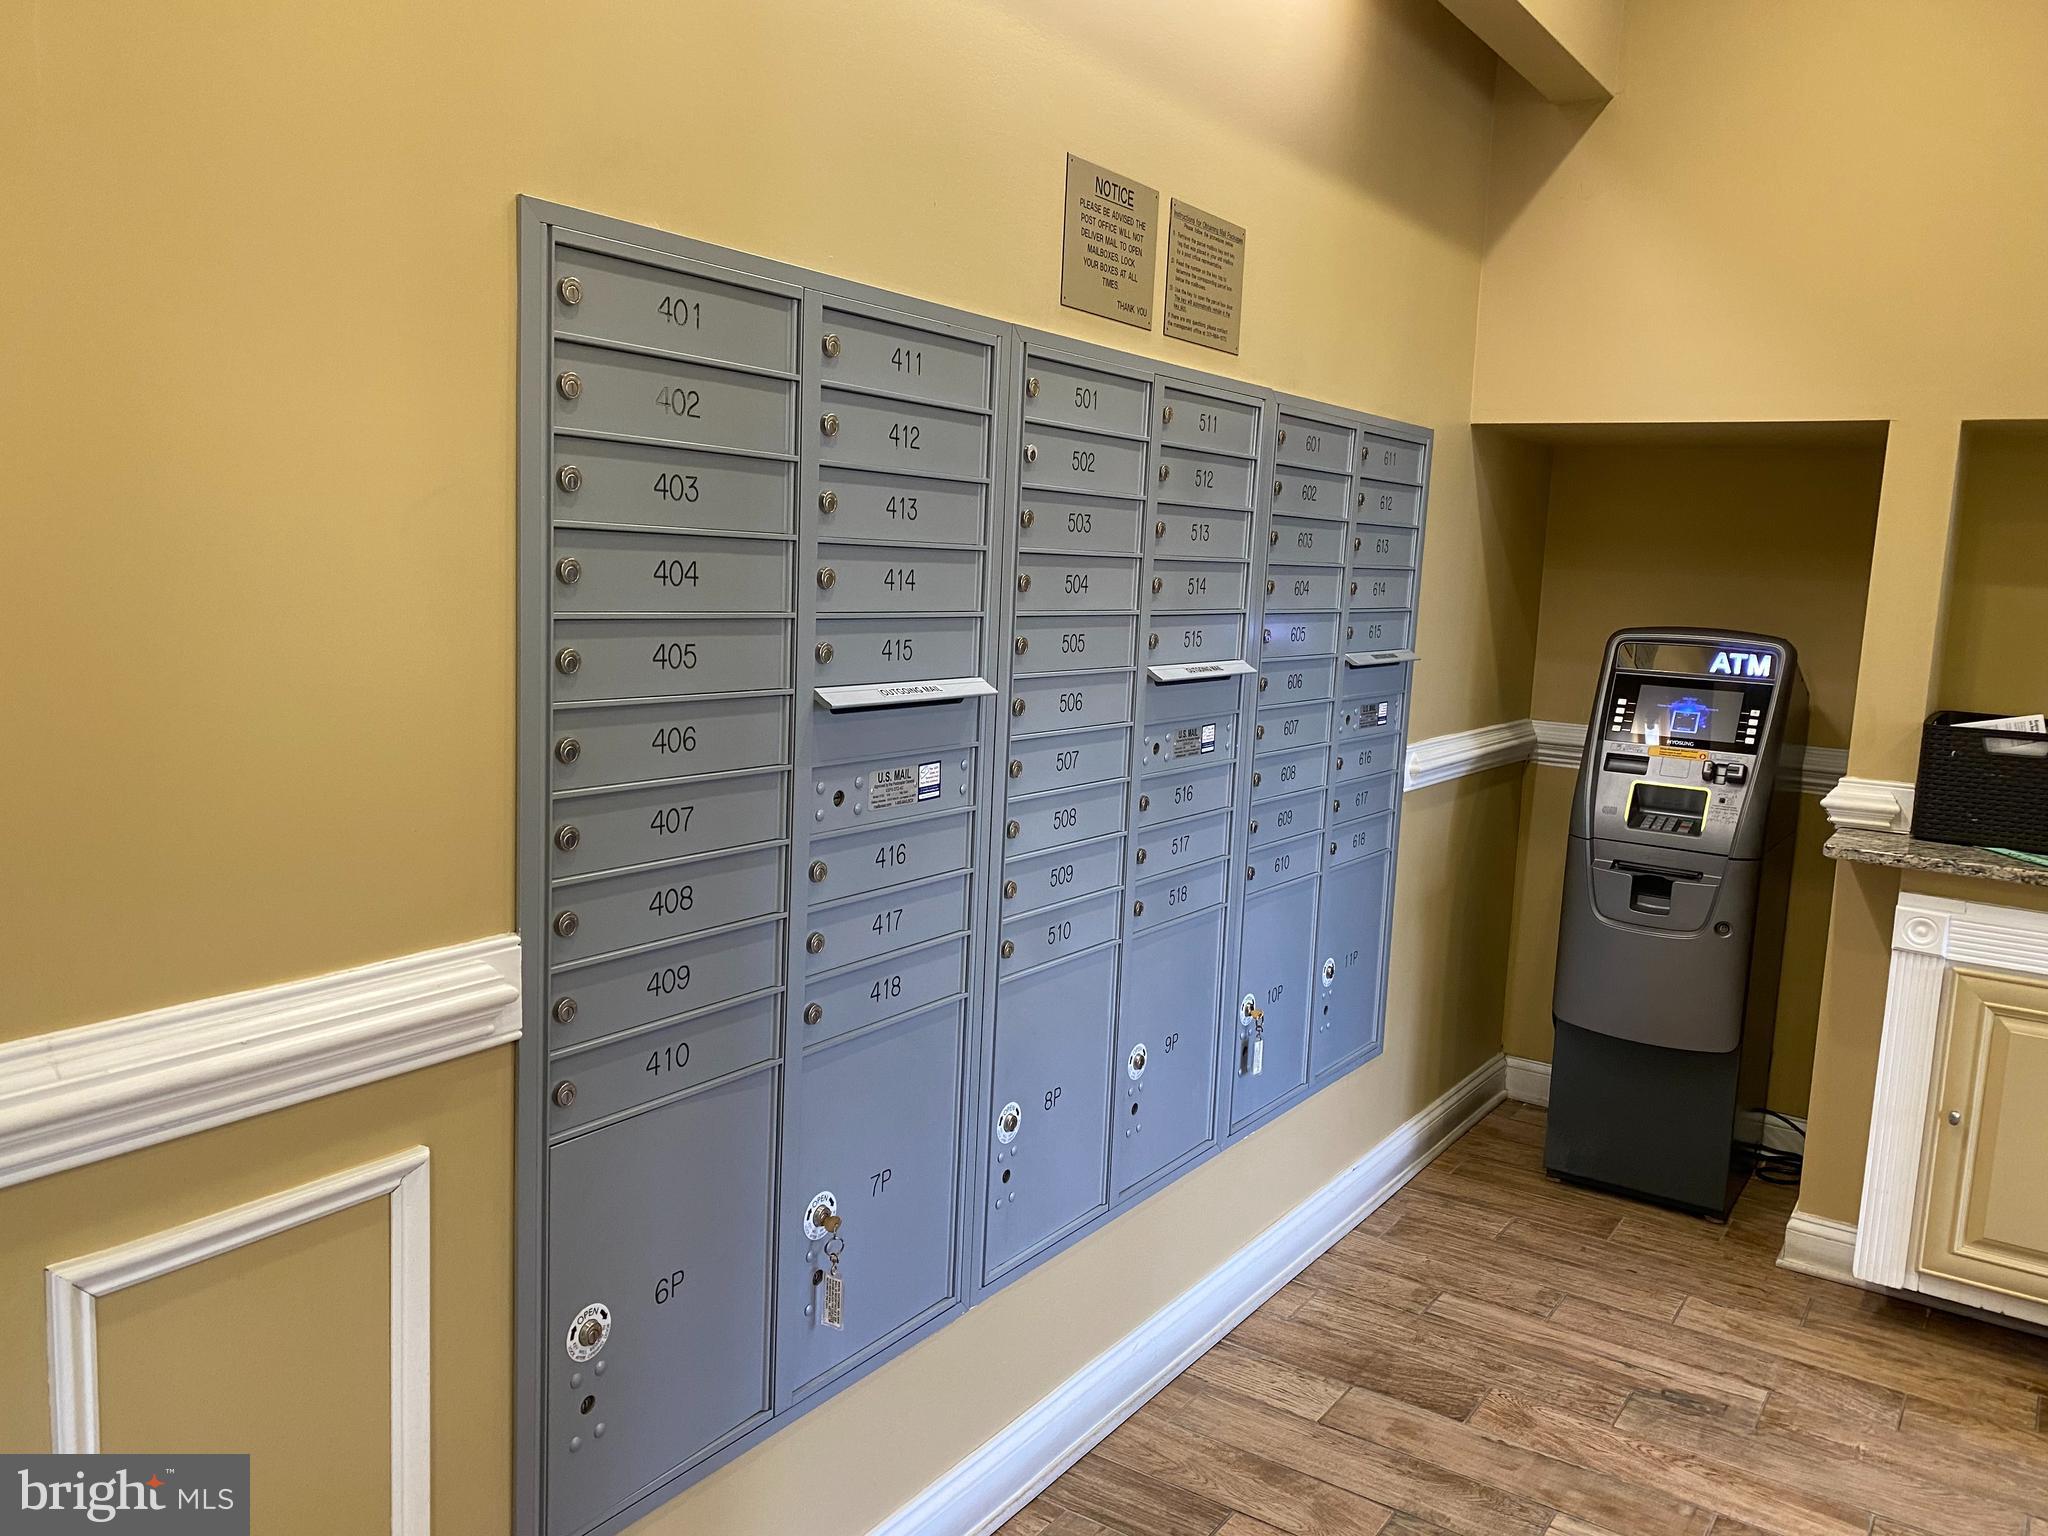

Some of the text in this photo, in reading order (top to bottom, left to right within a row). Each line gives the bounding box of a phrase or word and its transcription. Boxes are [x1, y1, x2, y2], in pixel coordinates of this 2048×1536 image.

[1095, 176, 1135, 208] NOTICE
[1080, 198, 1146, 231] PLEASE BE ADVISED THE
[1081, 213, 1144, 244] POST OFFICE WILL NOT
[1081, 227, 1104, 243] DELIVER
[1105, 236, 1118, 248] MAIL
[1120, 241, 1127, 252] TO
[1084, 257, 1138, 283] YOUR BOXES AT ALL
[1121, 256, 1136, 268] LOCK
[658, 296, 699, 329] 401
[1117, 301, 1147, 317] THANK YOU
[892, 348, 921, 375] 411
[656, 386, 700, 419] 402
[1075, 387, 1097, 410] 501
[1199, 414, 1217, 432] 511
[888, 424, 920, 449] 412
[1306, 435, 1320, 452] 601
[1072, 451, 1095, 472] 502
[1384, 451, 1396, 465] 611
[654, 473, 698, 502] 403
[1195, 470, 1213, 488] 512
[1302, 485, 1317, 501] 602
[1380, 496, 1392, 510] 612
[886, 496, 917, 520] 413
[1068, 513, 1091, 533] 503
[1191, 524, 1209, 541] 513
[1298, 532, 1312, 548] 603
[1376, 539, 1389, 553] 613
[654, 560, 699, 587] 404
[884, 569, 915, 591] 414
[1065, 575, 1088, 593] 504
[1188, 578, 1206, 595] 514
[1294, 580, 1309, 596] 604
[1373, 582, 1385, 596] 614
[1184, 631, 1202, 648] 515
[1291, 627, 1306, 642] 605
[1369, 624, 1382, 638] 615
[882, 639, 912, 661] 415
[1062, 634, 1085, 653] 505
[652, 643, 696, 669] 405
[1710, 652, 1772, 678] ATM
[880, 685, 944, 697] OUTGOING MAIL
[1288, 673, 1302, 689] 606
[1060, 692, 1082, 712] 506
[1178, 728, 1198, 739] U.S. MAIL
[1284, 720, 1299, 736] 607
[652, 726, 696, 754] 406
[1666, 739, 1694, 747] HYOSUNG
[1056, 751, 1079, 771] 507
[1359, 750, 1372, 765] 616
[878, 769, 911, 783] U.S. MAIL
[1281, 765, 1296, 782] 608
[1175, 785, 1193, 804] 516
[1356, 790, 1369, 807] 617
[650, 806, 694, 835] 407
[1054, 808, 1076, 830] 508
[1278, 810, 1292, 827] 609
[1172, 835, 1189, 855] 517
[1353, 832, 1365, 848] 618
[876, 844, 906, 868] 416
[1275, 854, 1291, 873] 610
[1050, 865, 1073, 887] 509
[648, 886, 693, 916] 408
[1169, 886, 1187, 906] 518
[872, 909, 902, 935] 417
[1048, 921, 1071, 944] 510
[1345, 950, 1359, 968] 11P
[646, 965, 690, 996] 409
[870, 976, 901, 1002] 418
[1268, 985, 1283, 1003] 10P
[1165, 1033, 1178, 1053] 9P
[646, 1043, 689, 1075] 410
[1044, 1087, 1061, 1110] 8P
[1004, 1104, 1015, 1115] OPEN
[871, 1169, 891, 1197] 7P
[812, 1194, 828, 1208] OPEN
[655, 1270, 684, 1304] 6P
[577, 1307, 600, 1325] OPEN
